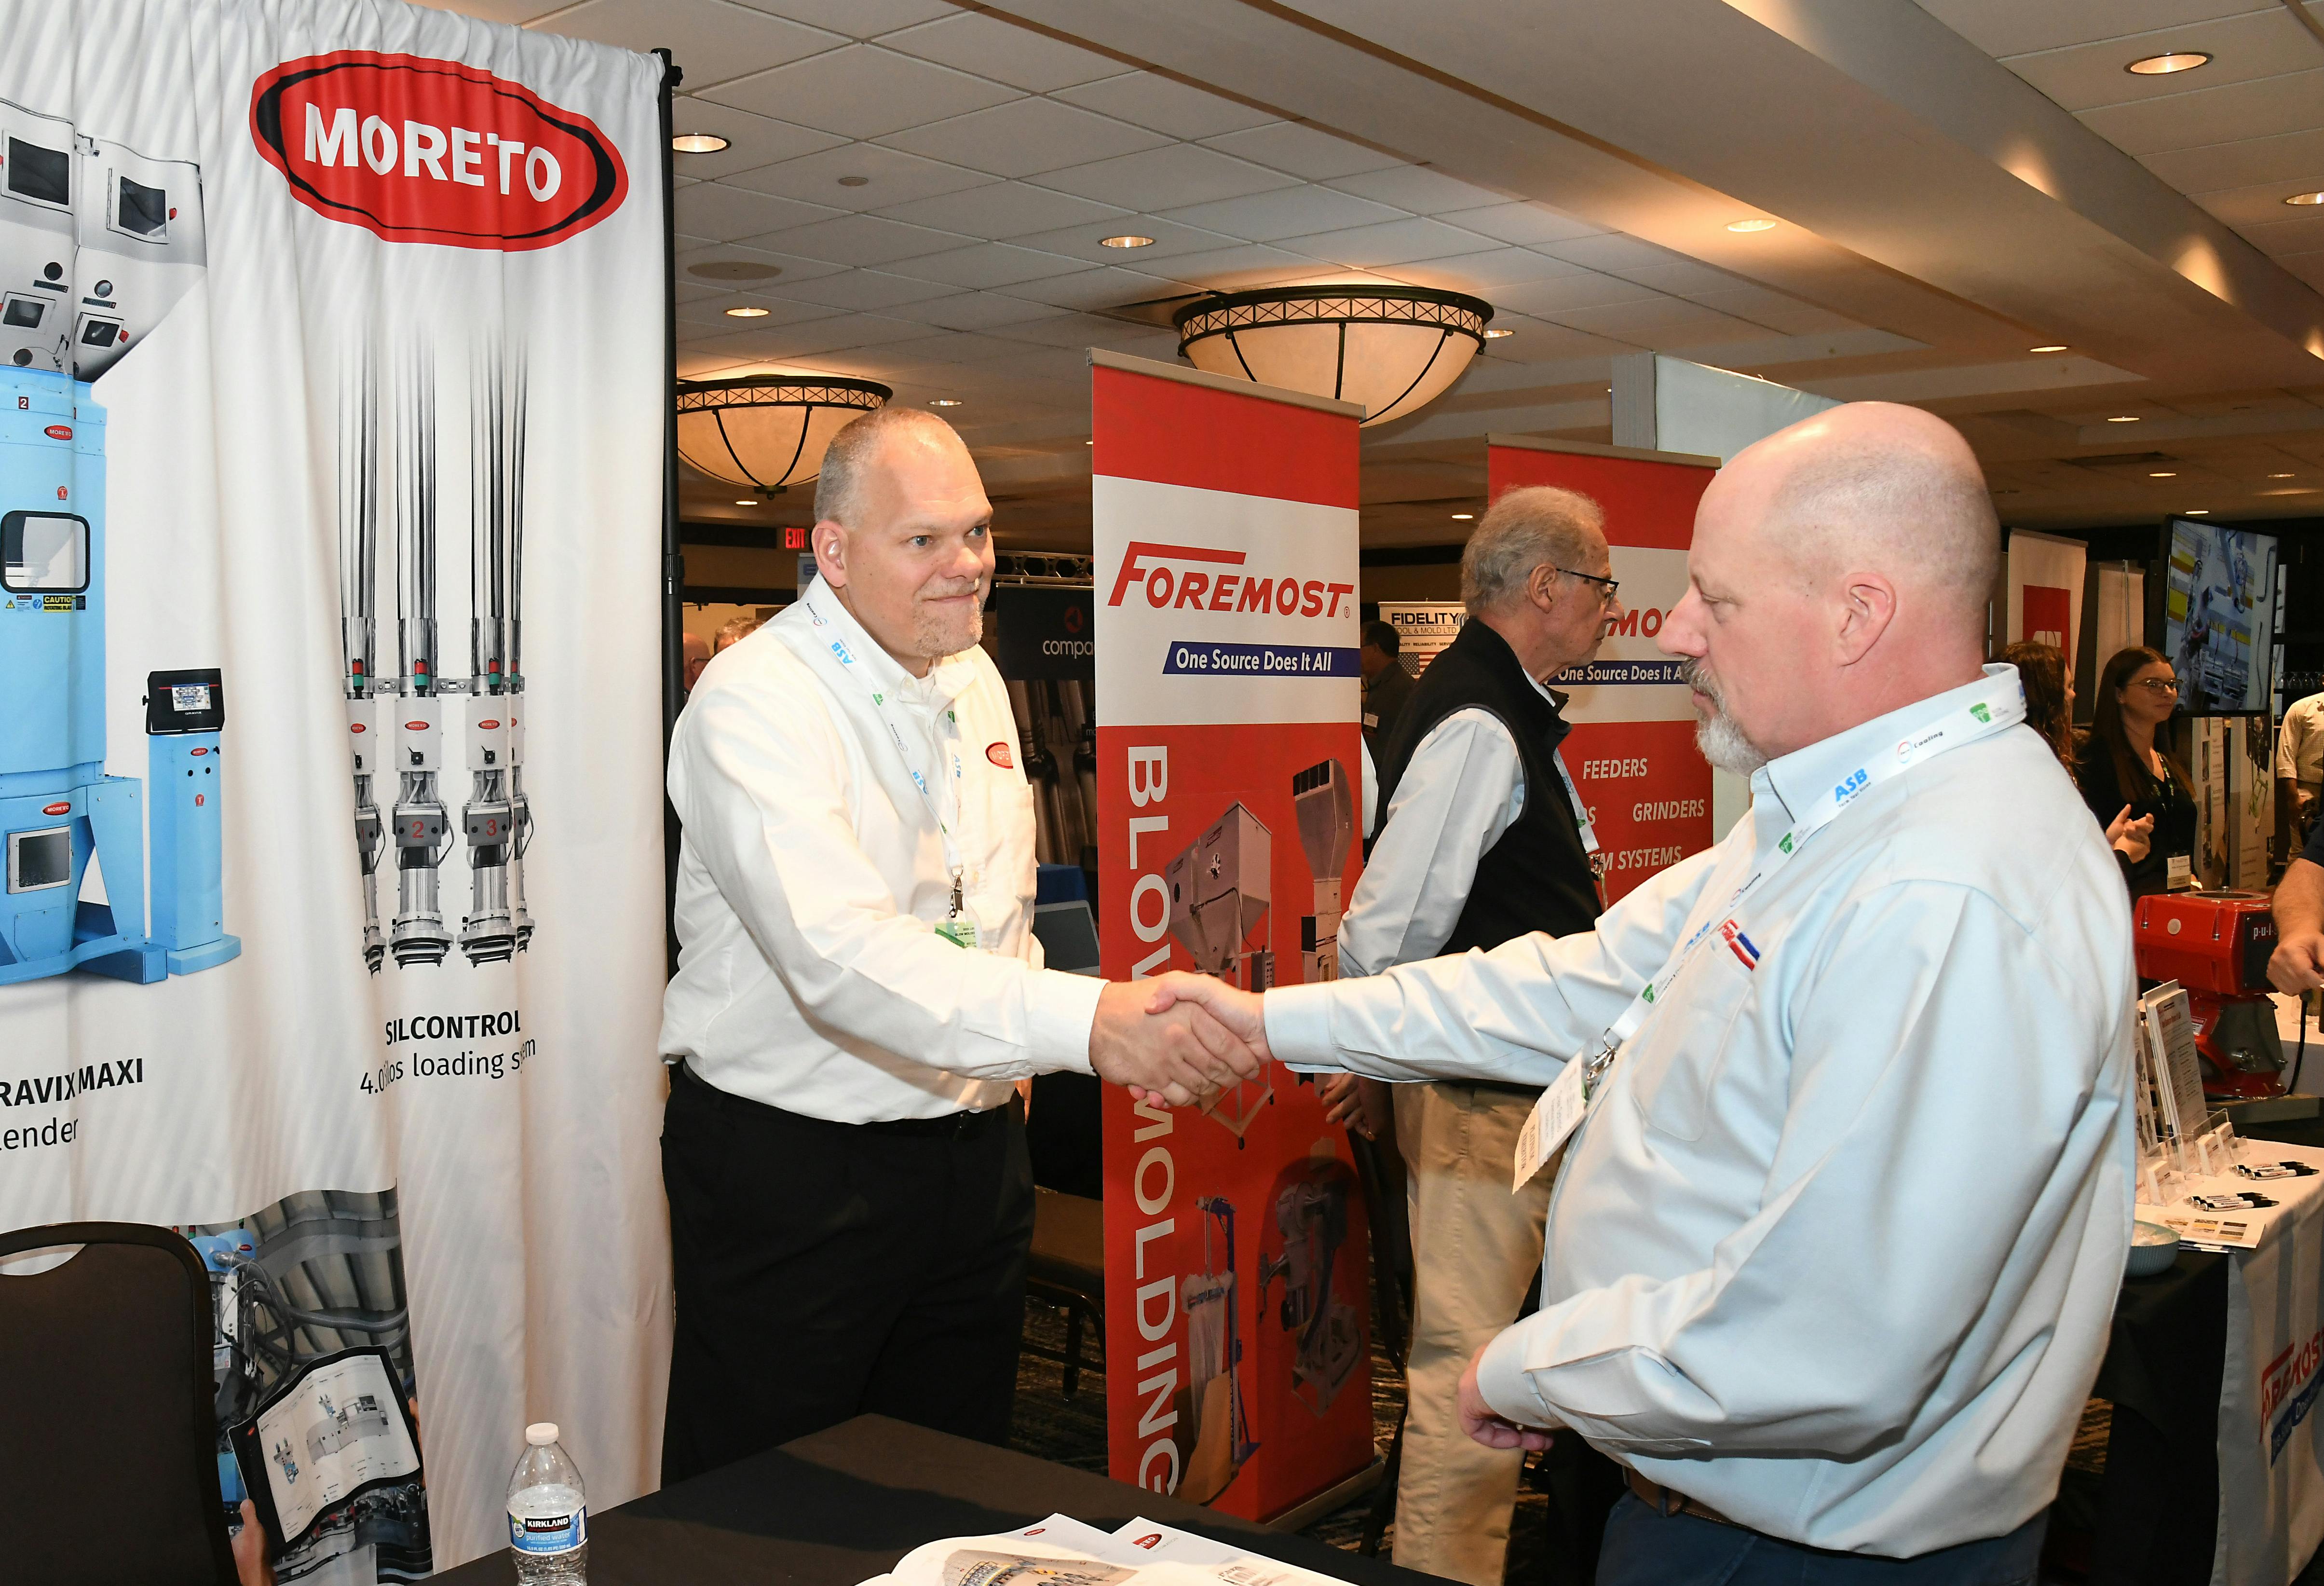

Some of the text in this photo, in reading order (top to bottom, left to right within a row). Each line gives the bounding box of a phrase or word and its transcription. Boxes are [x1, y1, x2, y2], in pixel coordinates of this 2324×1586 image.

[20, 398, 27, 408] 2
[786, 528, 805, 548] EXIT
[1107, 541, 1354, 618] FOREMOST
[1391, 613, 1459, 625] FIDELITY
[831, 642, 854, 664] ASB
[1176, 648, 1332, 671] One Source Does It All
[1558, 666, 1583, 682] One
[1587, 666, 1628, 681] Source
[1631, 666, 1660, 681] Does
[1663, 665, 1672, 681] It
[1914, 730, 1943, 749] Cooling
[1583, 758, 1647, 779] FEEDERS
[1835, 768, 1868, 802] ASB
[1632, 799, 1704, 822] GRINDERS
[412, 821, 424, 838] 2
[486, 819, 497, 836] 3
[1617, 846, 1682, 871] SYSTEMS
[386, 1010, 521, 1045] SILCONTROL
[413, 1051, 504, 1079] loading
[78, 1058, 143, 1094] MAXI
[527, 1518, 569, 1528] KIRKLAND
